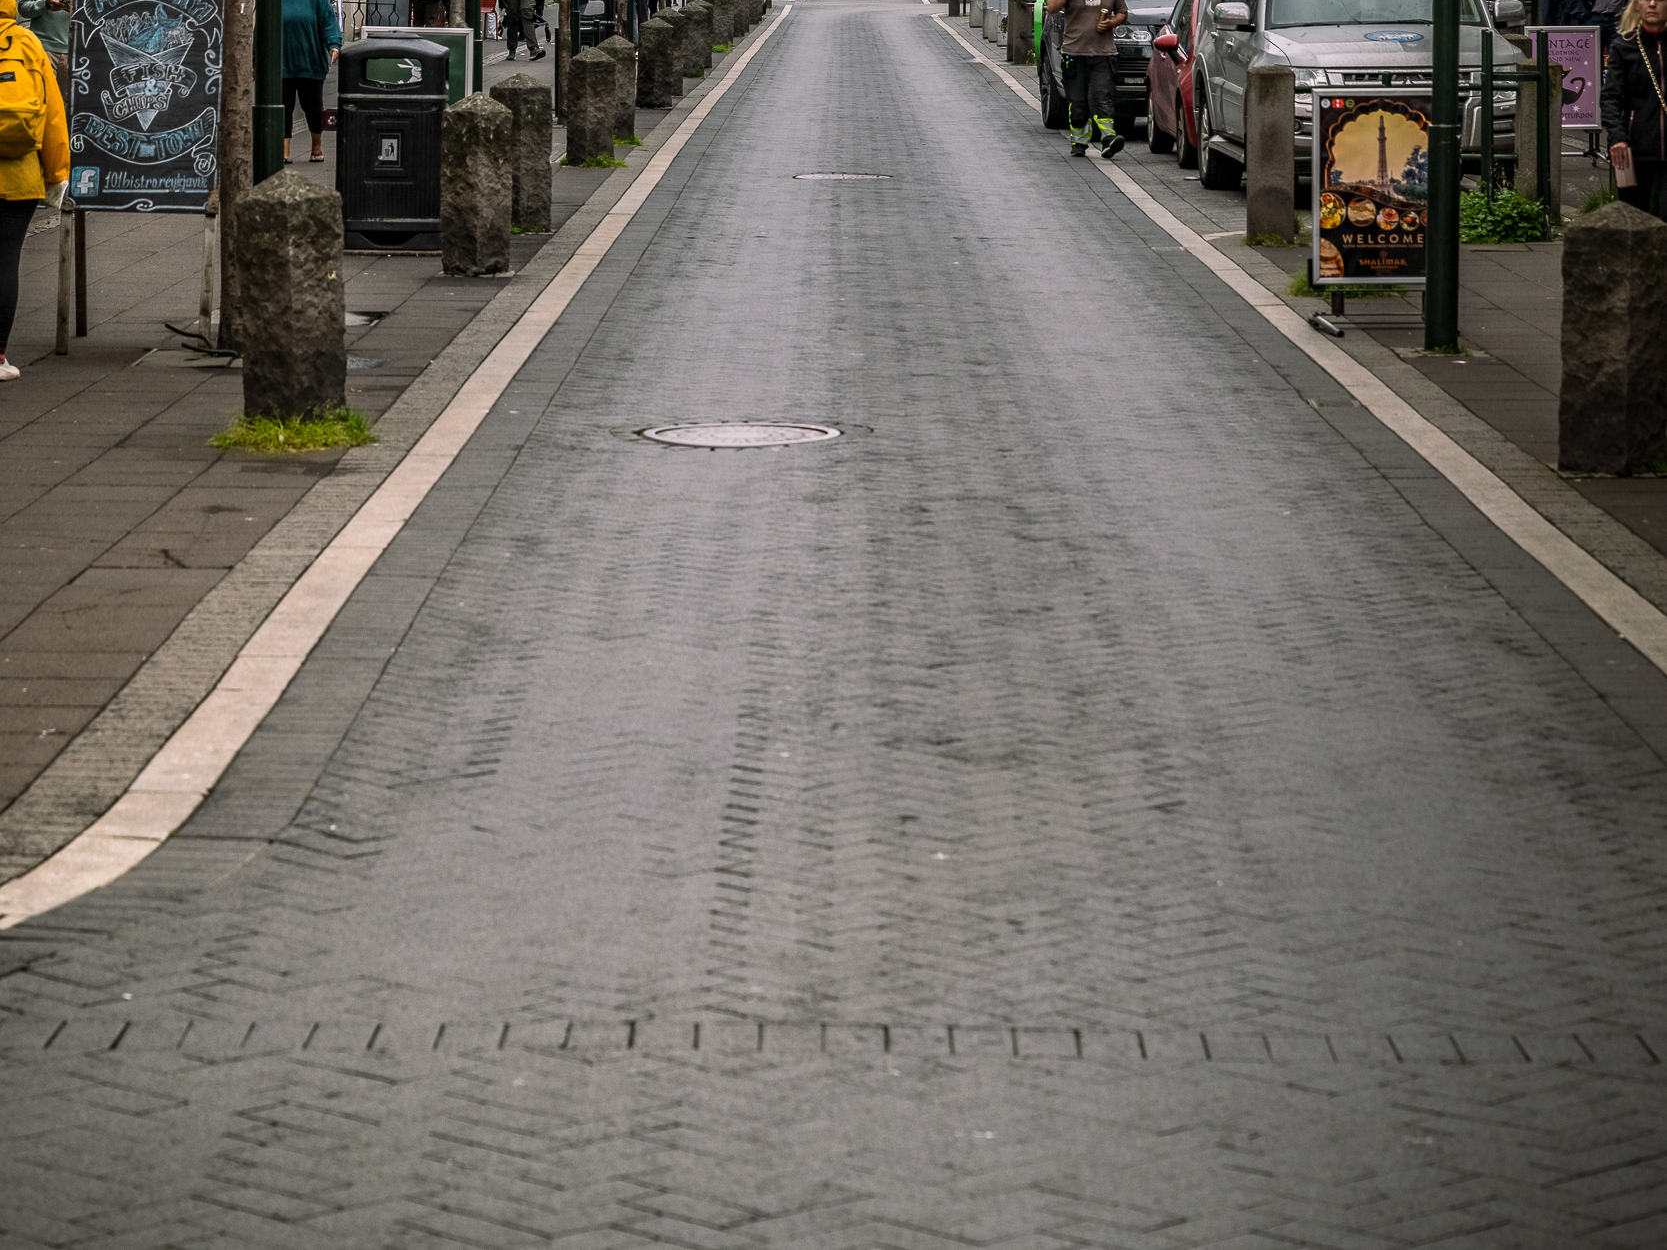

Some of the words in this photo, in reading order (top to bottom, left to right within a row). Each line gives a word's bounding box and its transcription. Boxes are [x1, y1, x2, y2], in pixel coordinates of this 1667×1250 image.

[1535, 38, 1590, 49] NTAGE
[121, 63, 186, 83] FISH
[144, 78, 160, 96] &
[112, 93, 168, 118] CHIPS
[84, 116, 148, 160] BEST
[1342, 233, 1424, 244] WELCOME
[1358, 258, 1408, 266] SHALIMAR
